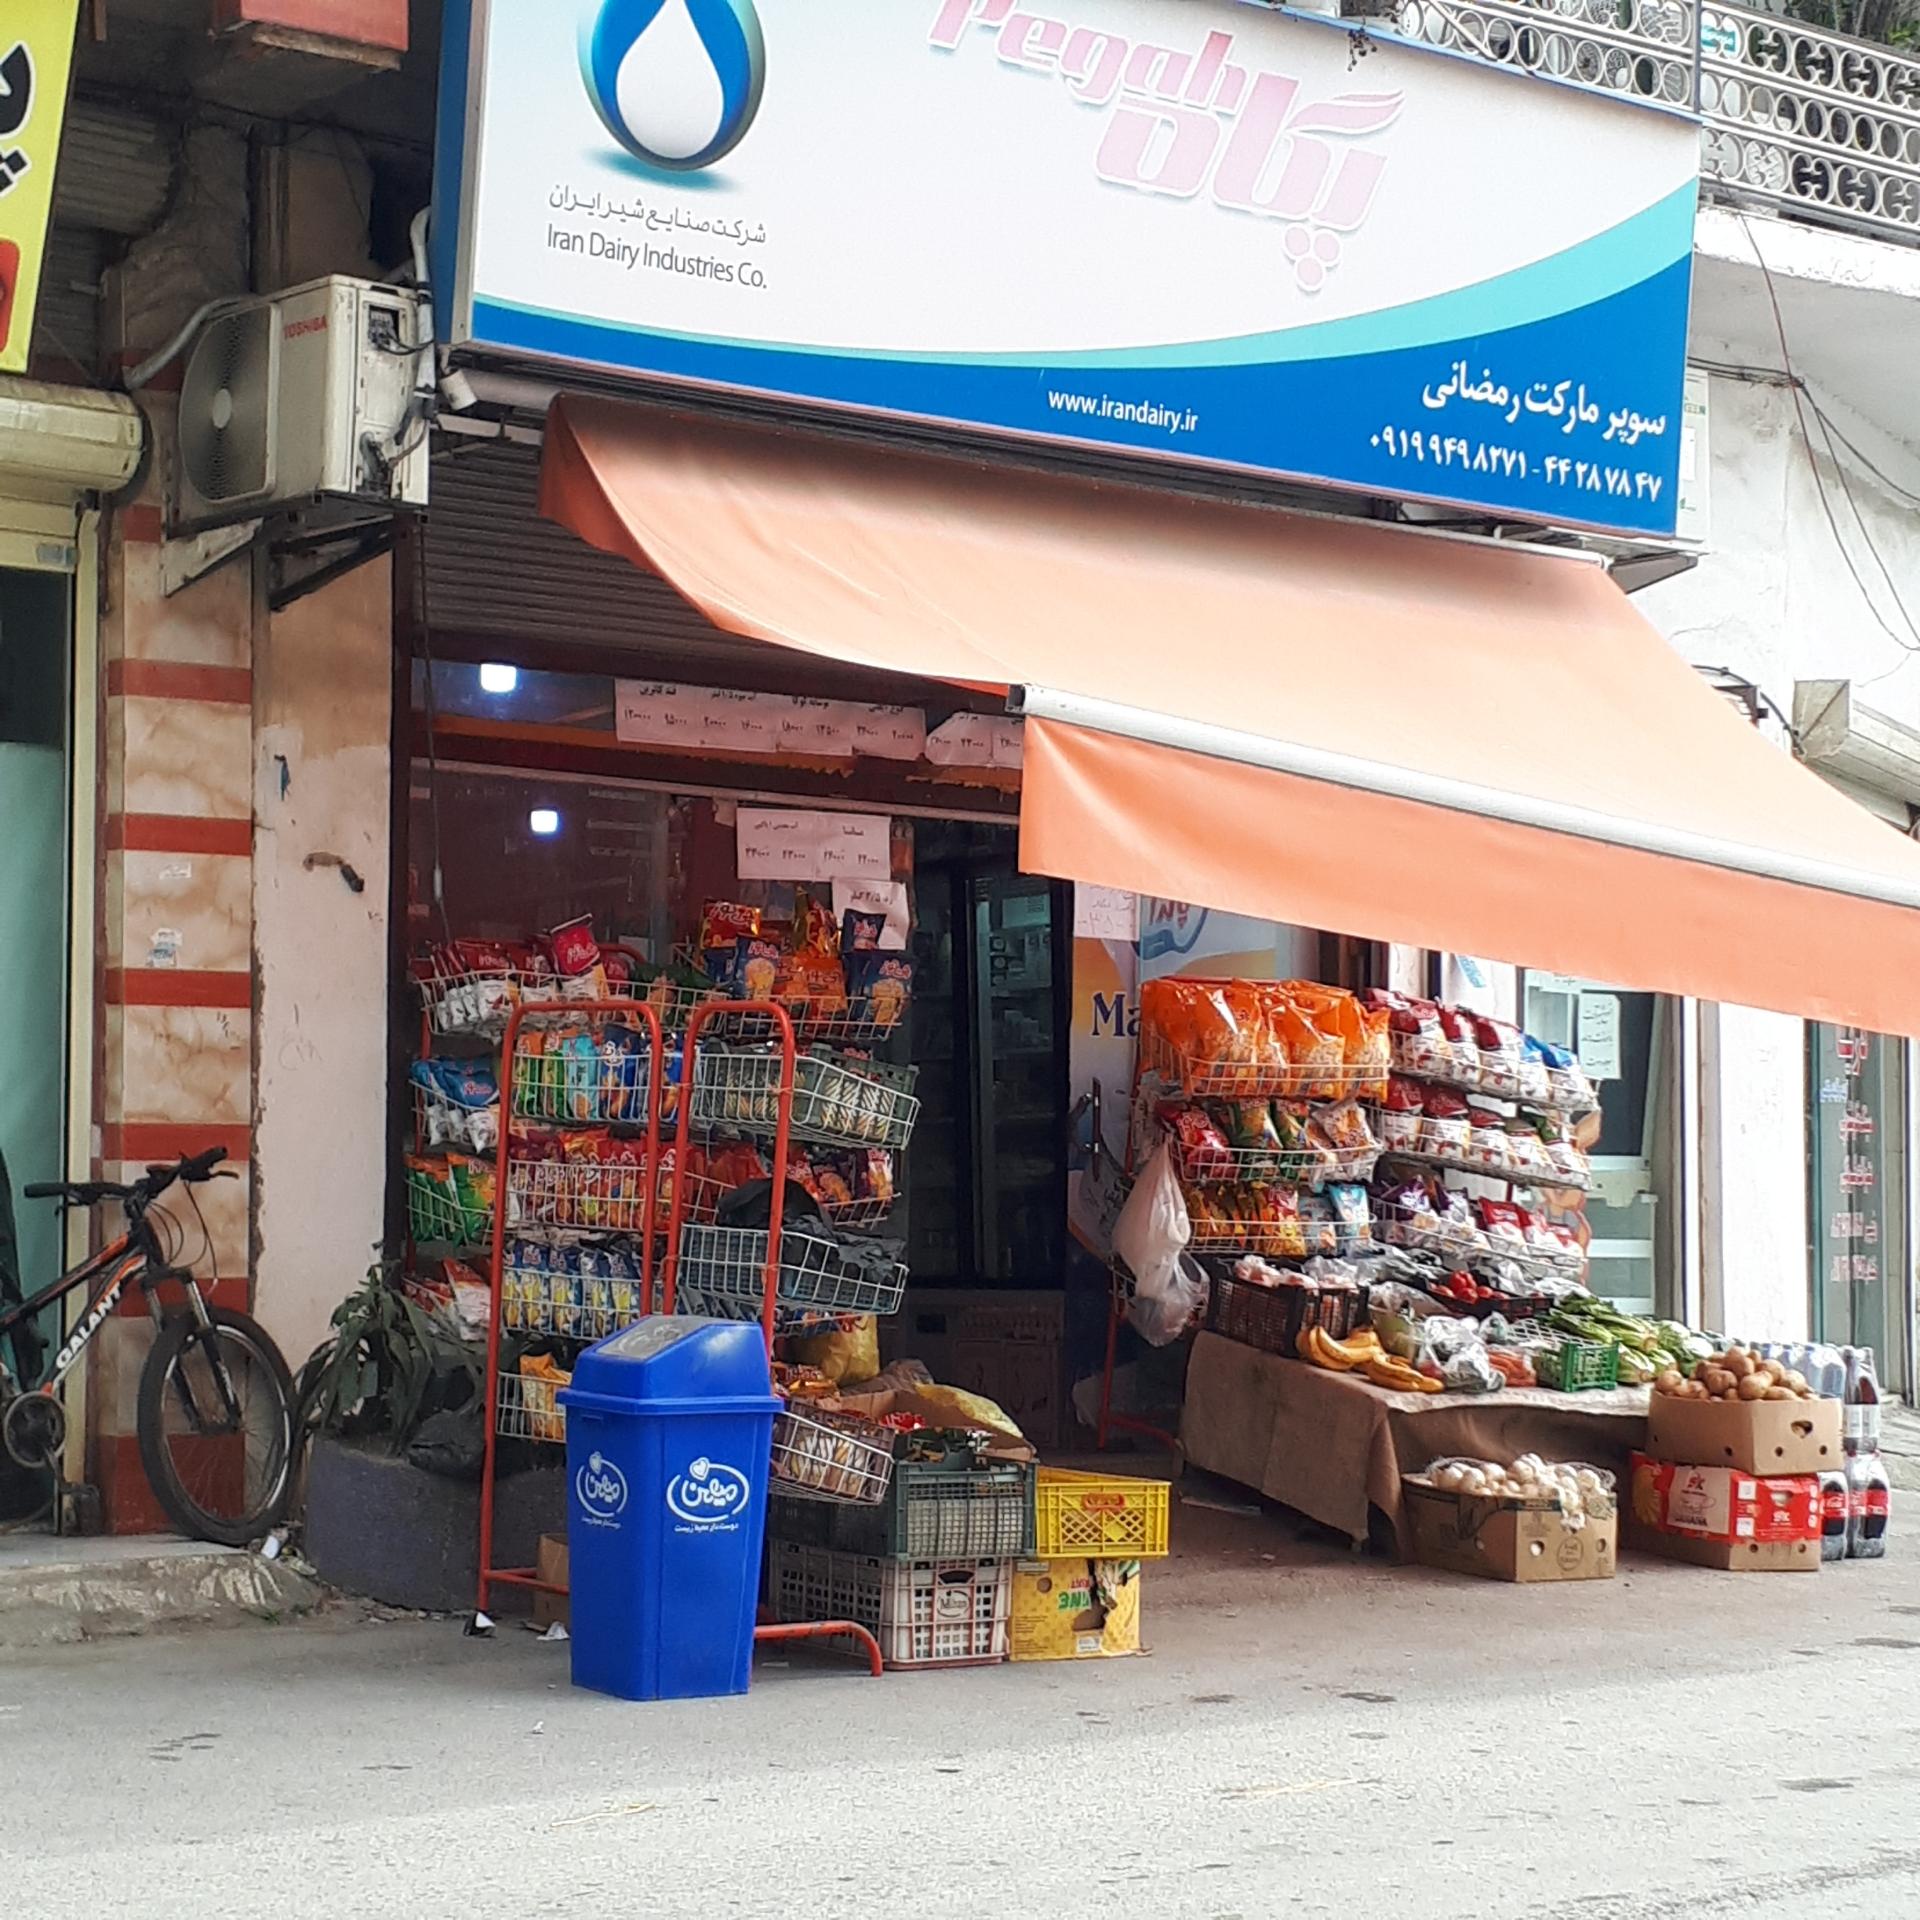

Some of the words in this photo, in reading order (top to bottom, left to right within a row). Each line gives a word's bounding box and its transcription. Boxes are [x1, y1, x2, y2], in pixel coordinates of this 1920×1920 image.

[927, 0, 1249, 115] Pegah
[549, 184, 601, 216] ایران
[598, 198, 644, 223] شیر
[645, 207, 710, 232] صنایع
[711, 218, 766, 246] شرکت
[548, 223, 584, 253] Iran
[589, 232, 640, 270] Dairy
[643, 242, 734, 282] Industries
[738, 262, 768, 289] Co.
[284, 315, 328, 340] TOSHIBA
[1048, 389, 1199, 434] www.irandairy.ir
[1422, 360, 1521, 424] رمضانی
[1523, 379, 1600, 434] مارکت
[1602, 407, 1667, 445] سوپر
[55, 1281, 121, 1369] GALANT
